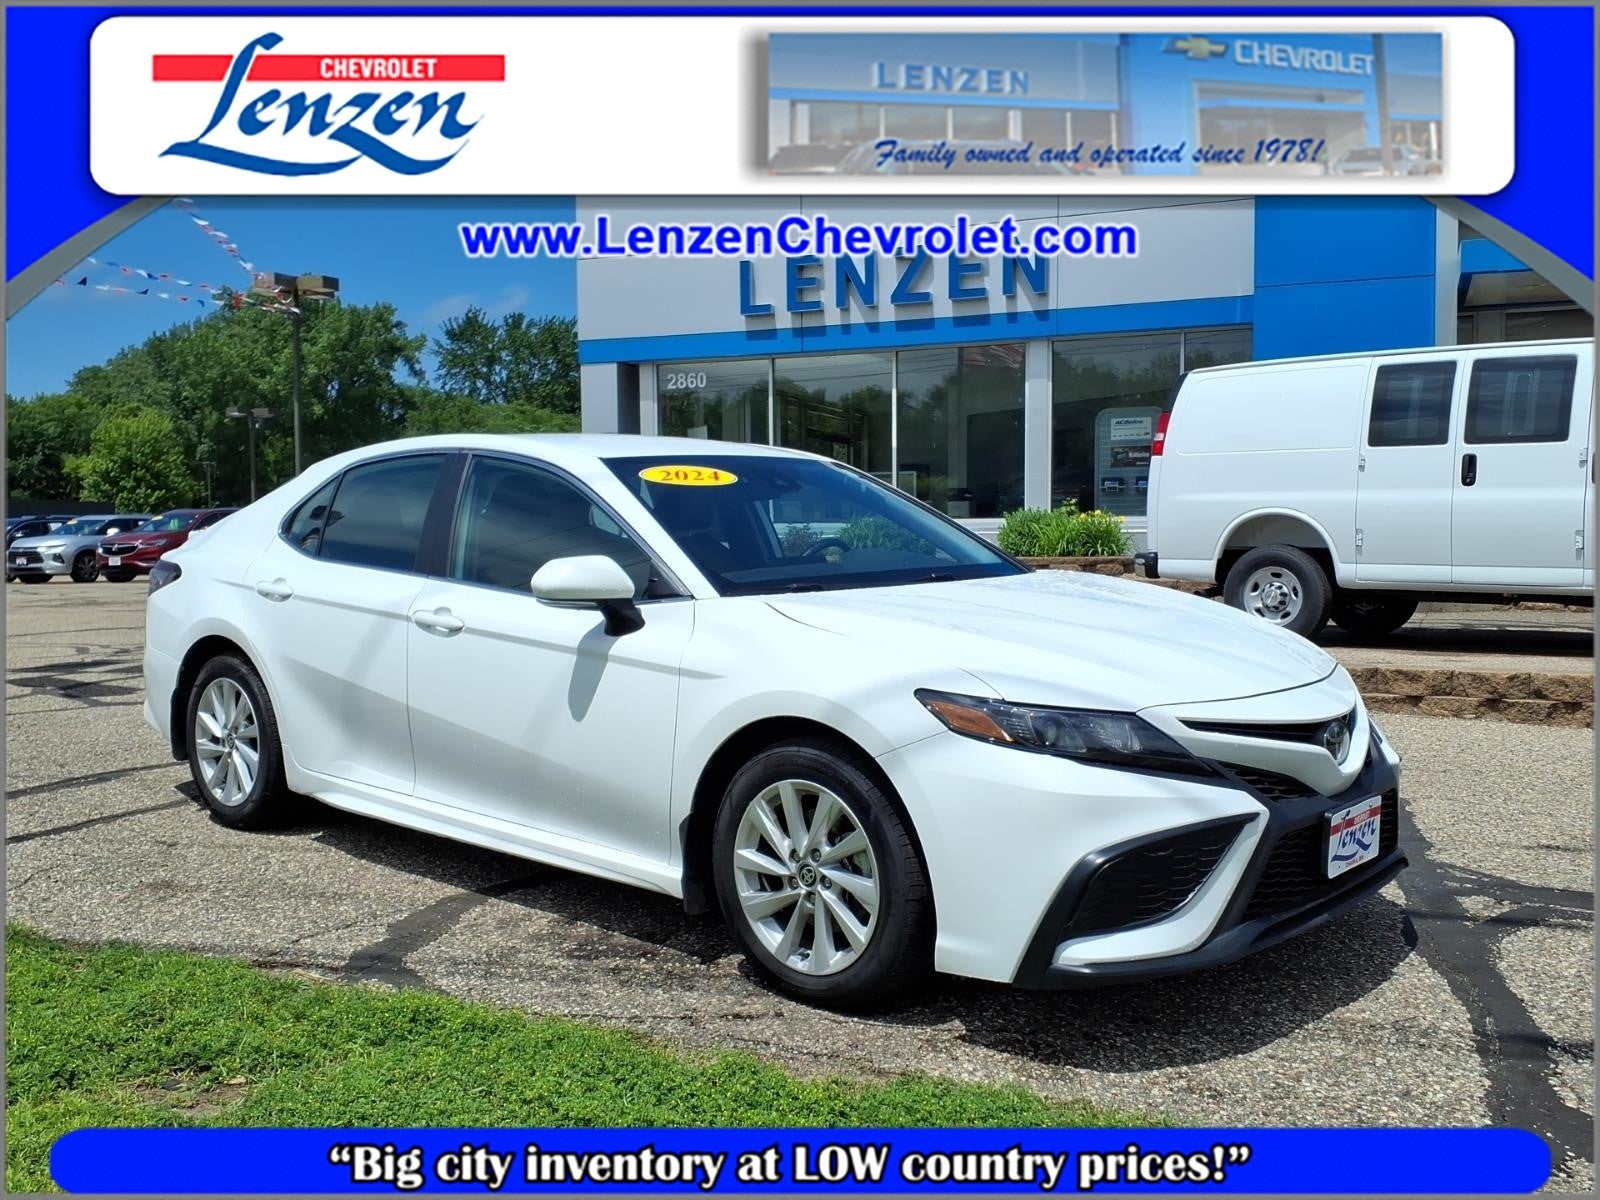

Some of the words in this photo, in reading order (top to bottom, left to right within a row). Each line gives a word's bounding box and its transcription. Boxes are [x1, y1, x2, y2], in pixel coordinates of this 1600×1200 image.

[739, 236, 1048, 317] LENZEN
[666, 372, 707, 390] 2860
[659, 469, 721, 481] 2024
